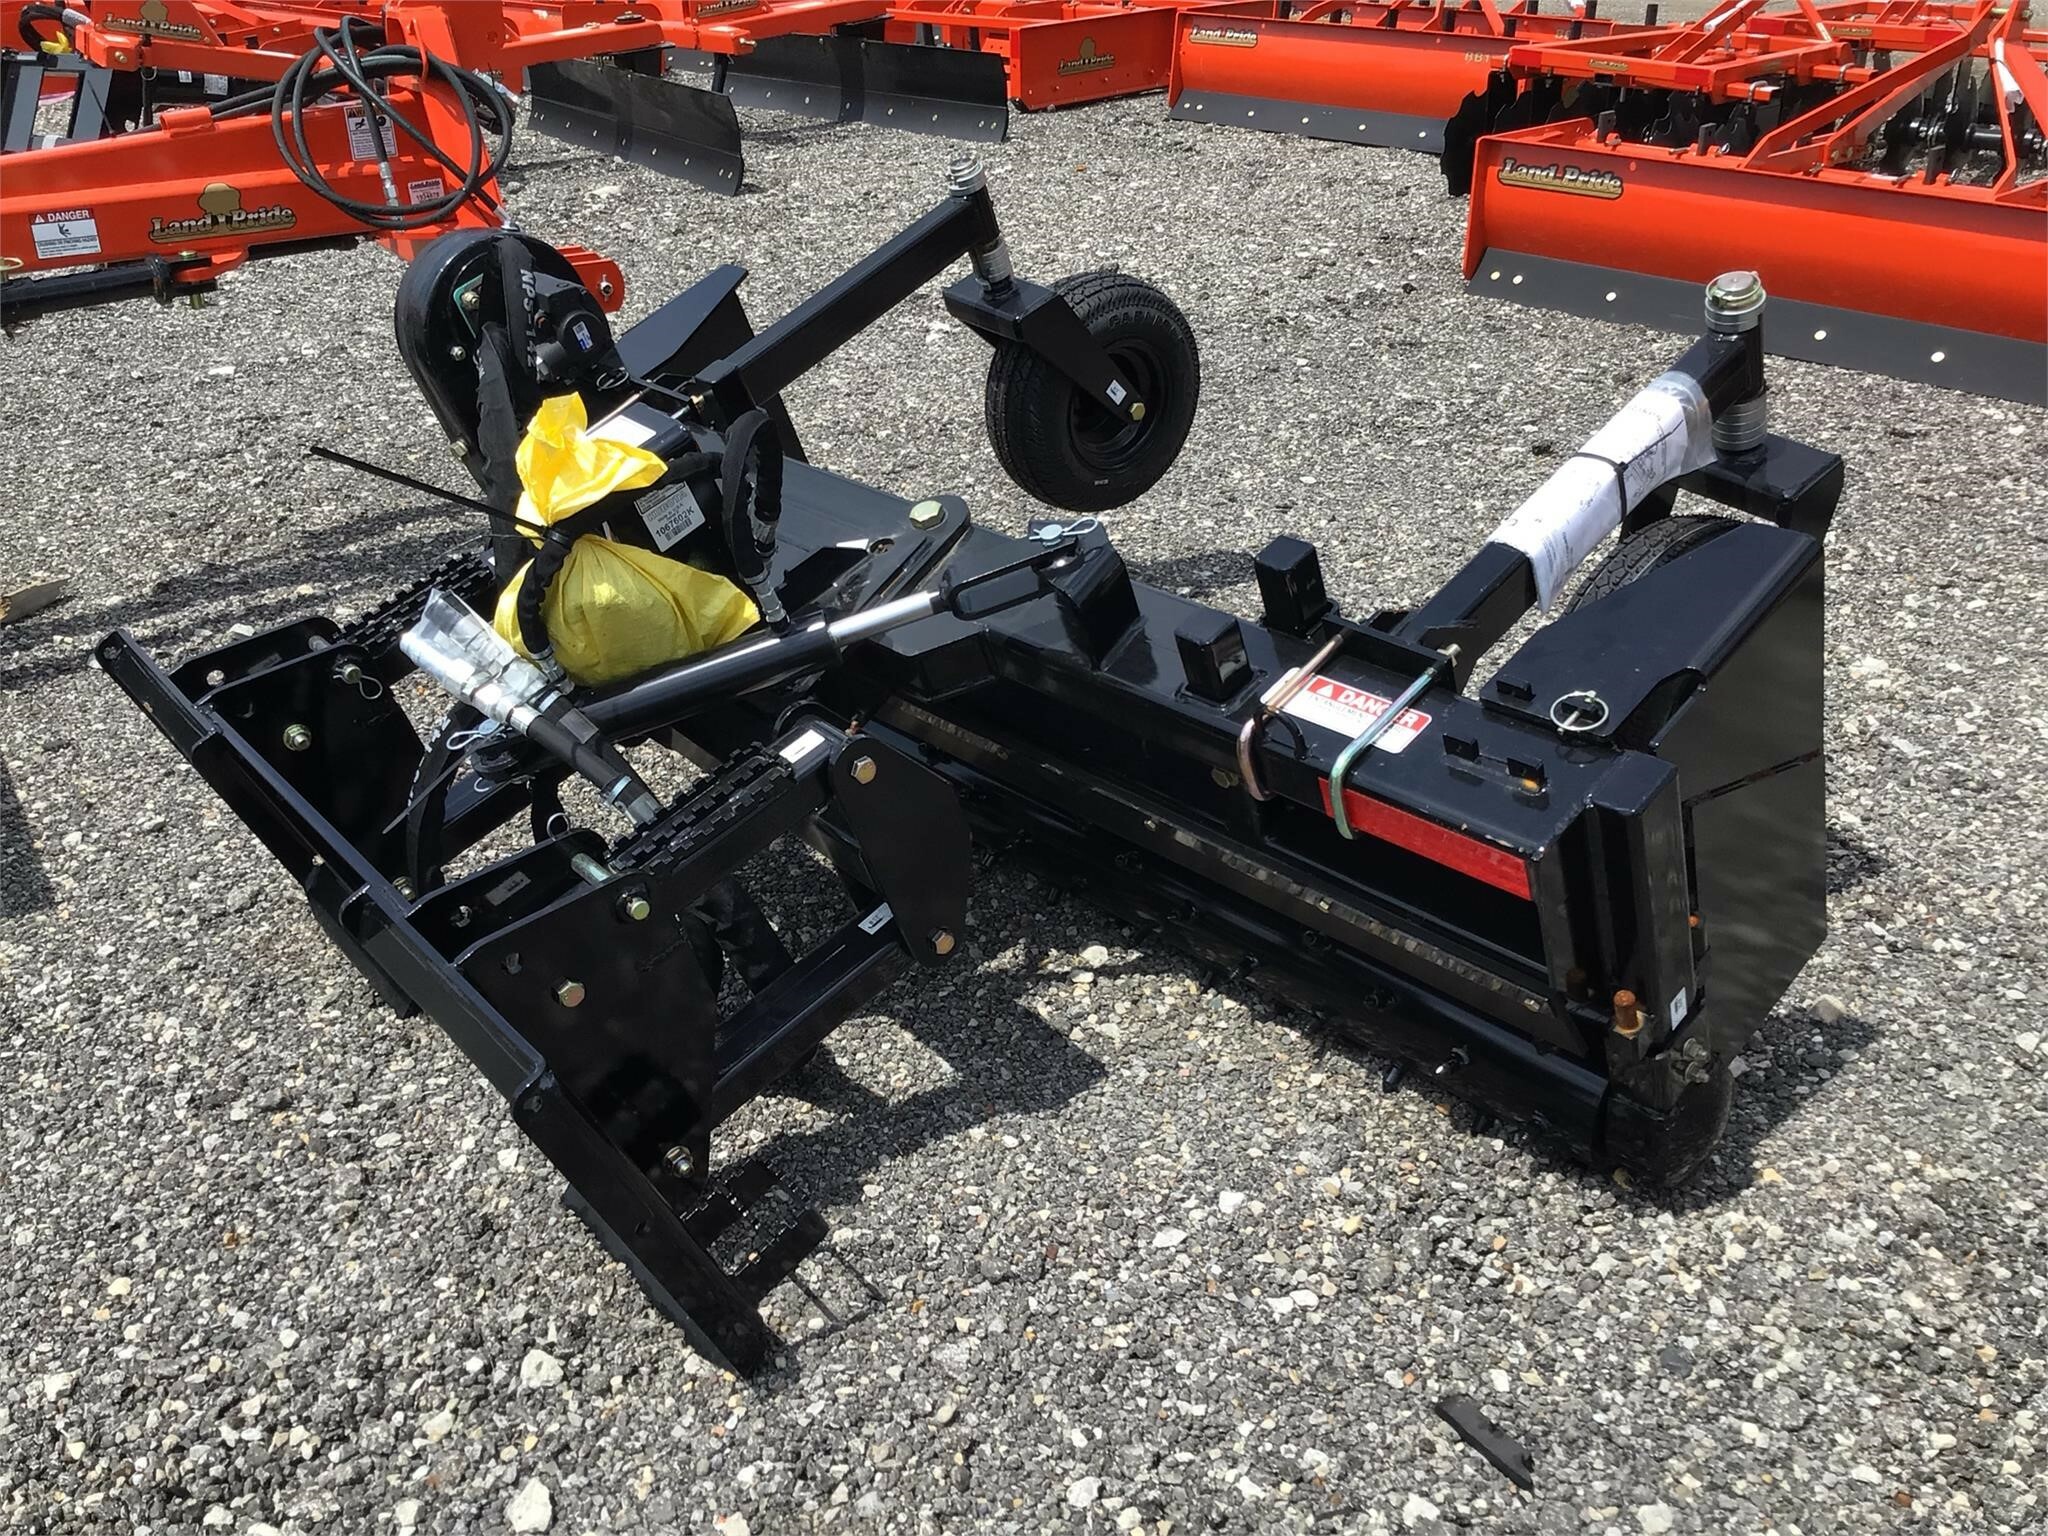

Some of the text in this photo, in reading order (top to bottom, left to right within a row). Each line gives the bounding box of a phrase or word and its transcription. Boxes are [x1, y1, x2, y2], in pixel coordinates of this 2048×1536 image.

[105, 13, 147, 30] Land
[1191, 25, 1257, 43] Land Pride
[1500, 158, 1621, 192] Land Pride
[47, 209, 90, 222] DANGER
[152, 204, 296, 237] Land Pride
[656, 506, 695, 537] 1067602K
[1338, 688, 1419, 728] DANR
